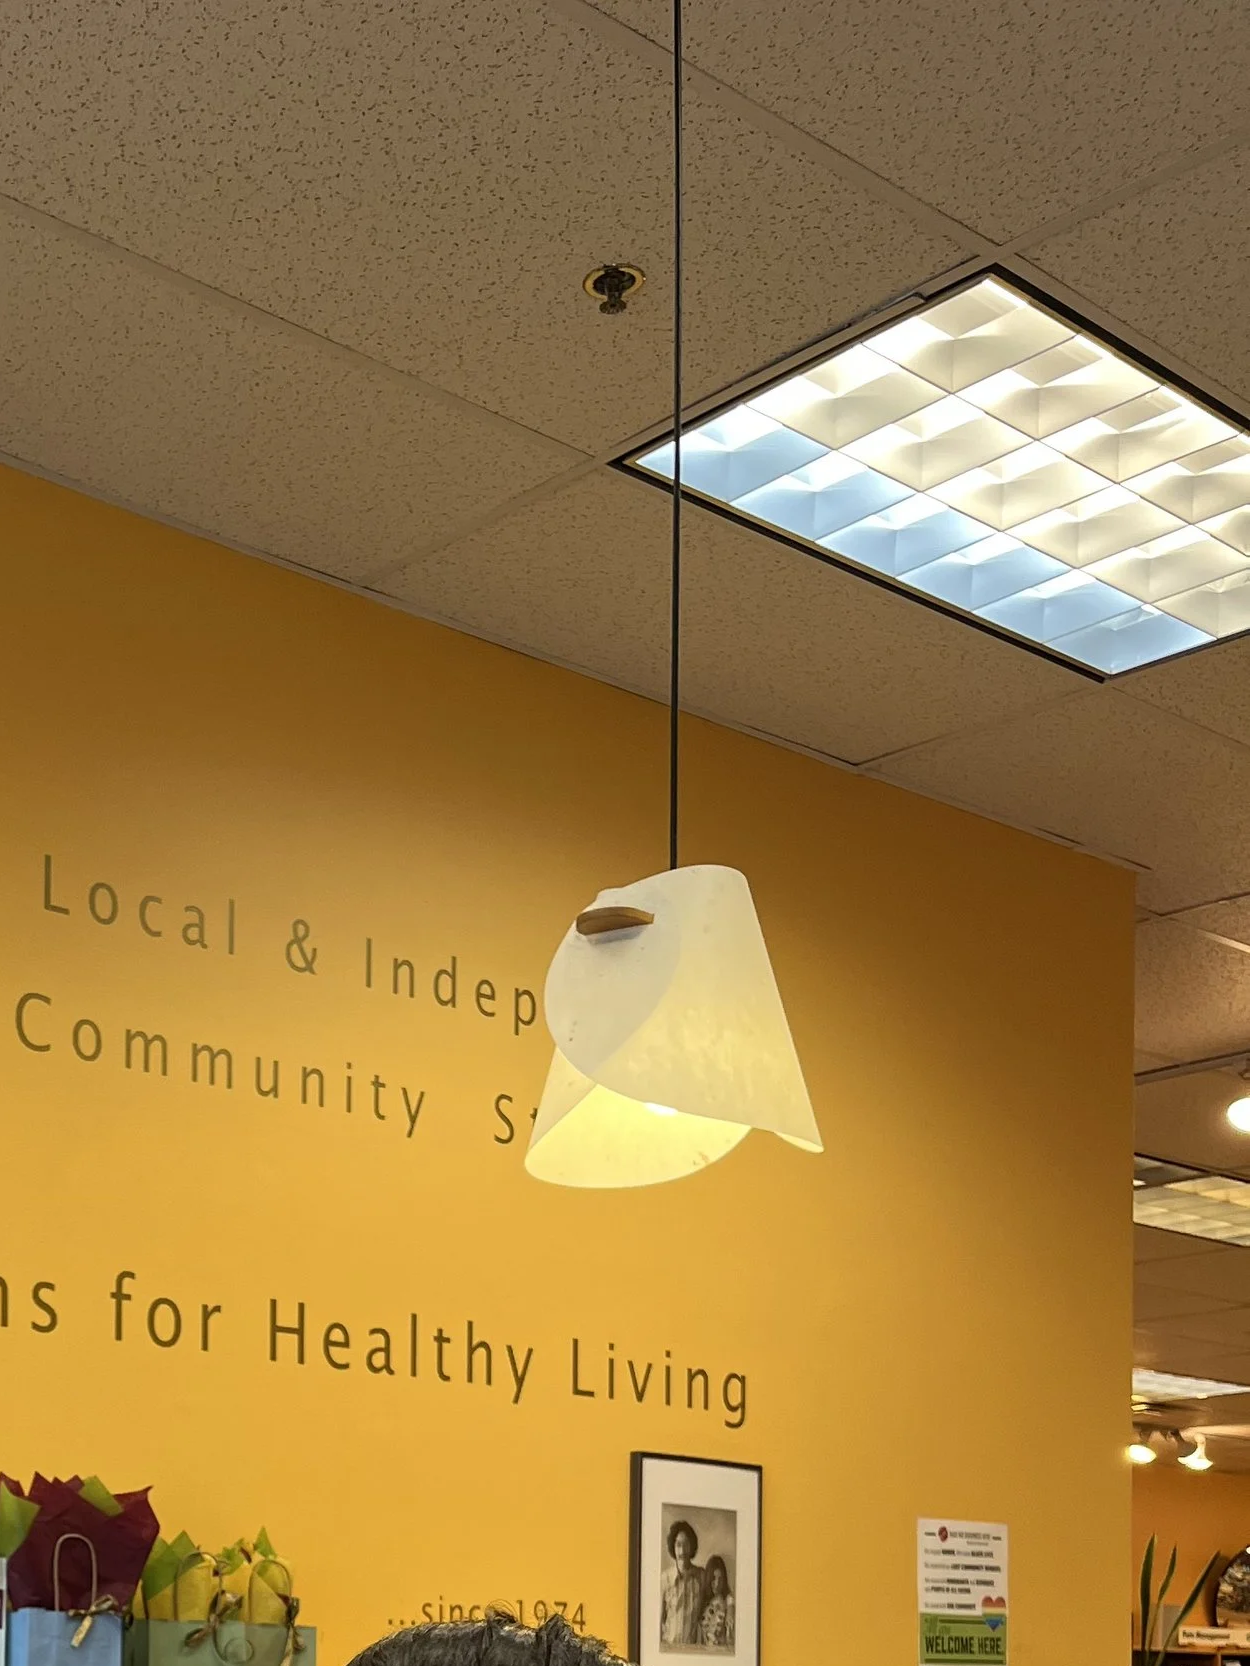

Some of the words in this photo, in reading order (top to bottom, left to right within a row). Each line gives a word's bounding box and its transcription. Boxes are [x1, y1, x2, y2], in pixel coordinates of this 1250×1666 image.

[42, 854, 236, 956] Local
[284, 918, 319, 976] &
[364, 937, 539, 1036] Indep
[14, 992, 426, 1139] Community
[492, 1093, 538, 1146] S
[110, 1270, 222, 1353] for
[268, 1298, 535, 1404] Healthy
[571, 1338, 749, 1431] Living
[387, 1595, 483, 1626] ...sinc
[925, 1634, 975, 1655] WELCOME
